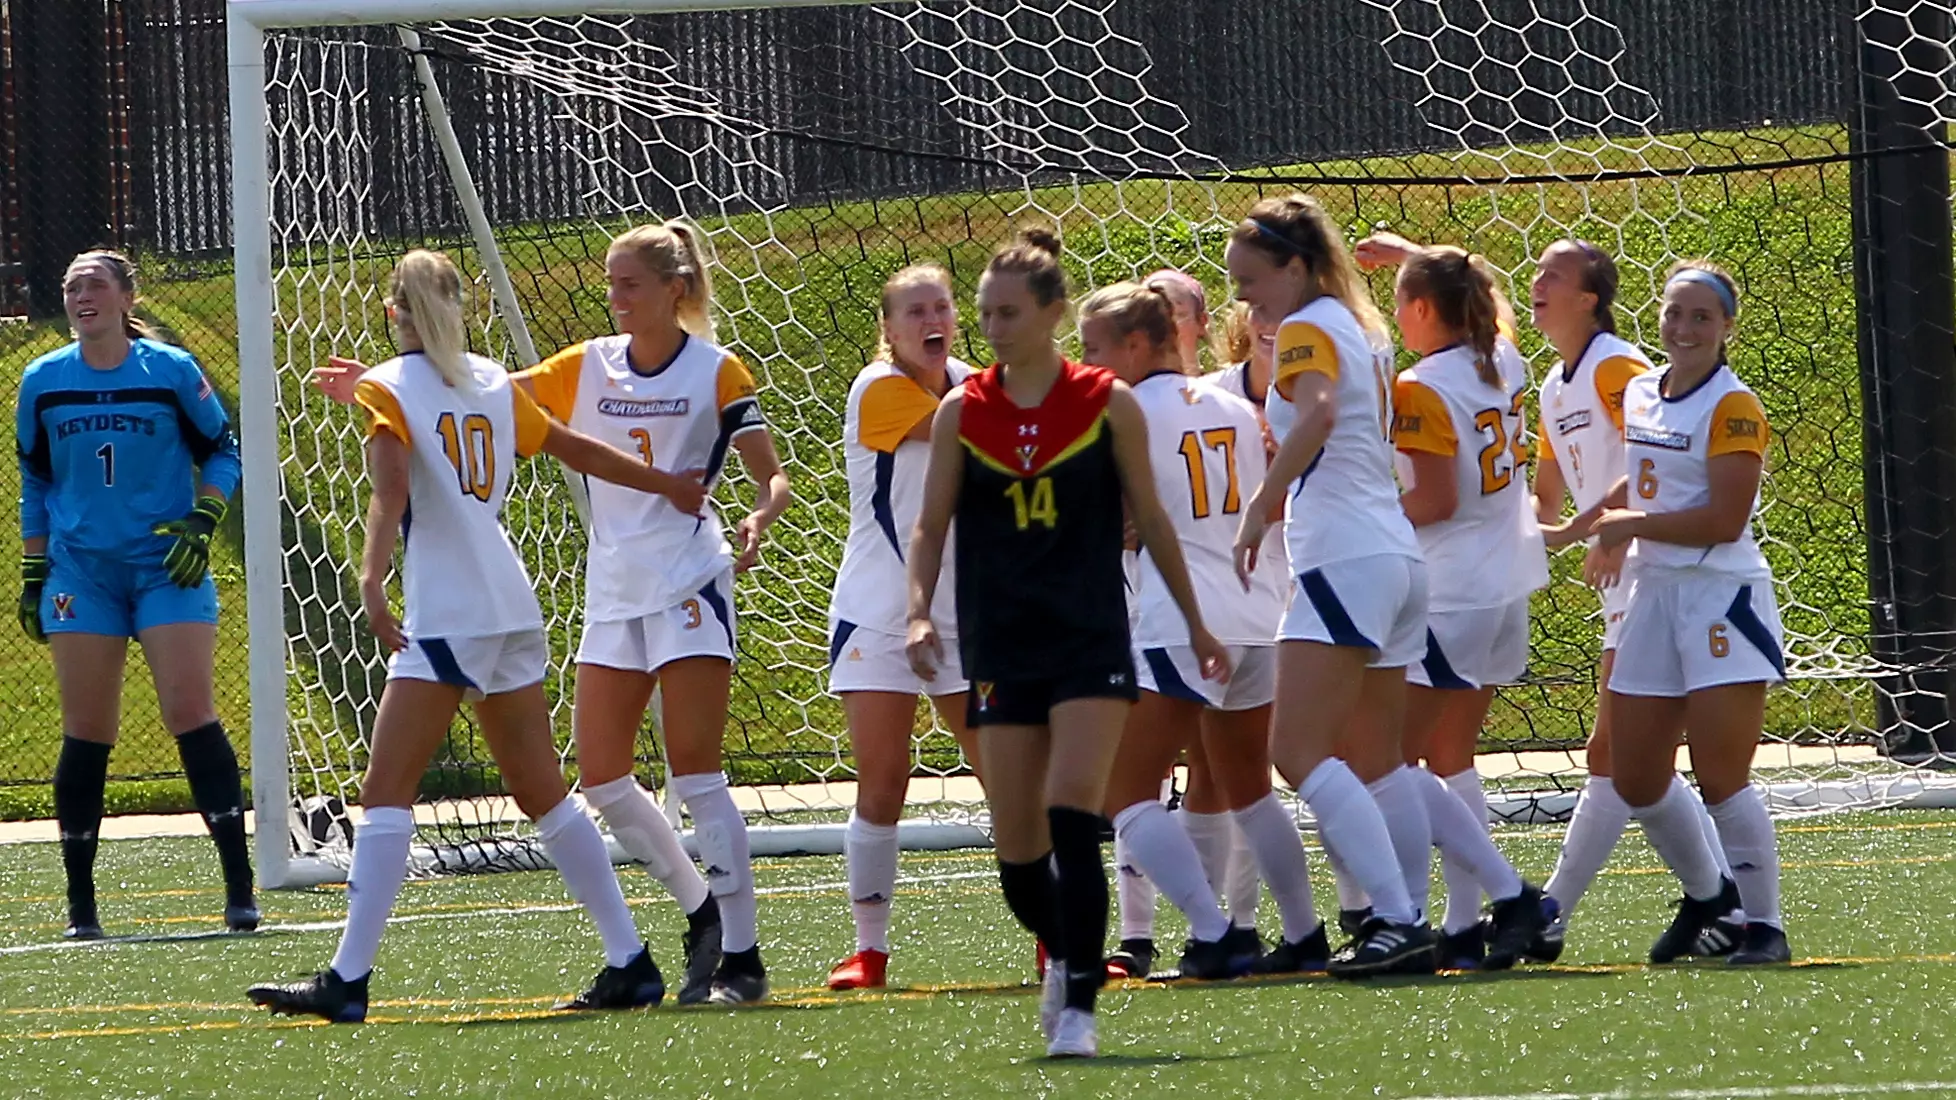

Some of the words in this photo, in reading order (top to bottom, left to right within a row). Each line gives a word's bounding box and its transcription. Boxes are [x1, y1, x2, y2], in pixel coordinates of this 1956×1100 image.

[57, 413, 156, 441] KEYDETS
[627, 427, 654, 467] 3
[96, 442, 114, 487] 1
[434, 411, 496, 504] 10
[1177, 426, 1241, 520] 17
[1637, 458, 1659, 499] 6
[1003, 476, 1058, 531] 14
[680, 598, 702, 630] 3
[1708, 623, 1731, 658] 6
